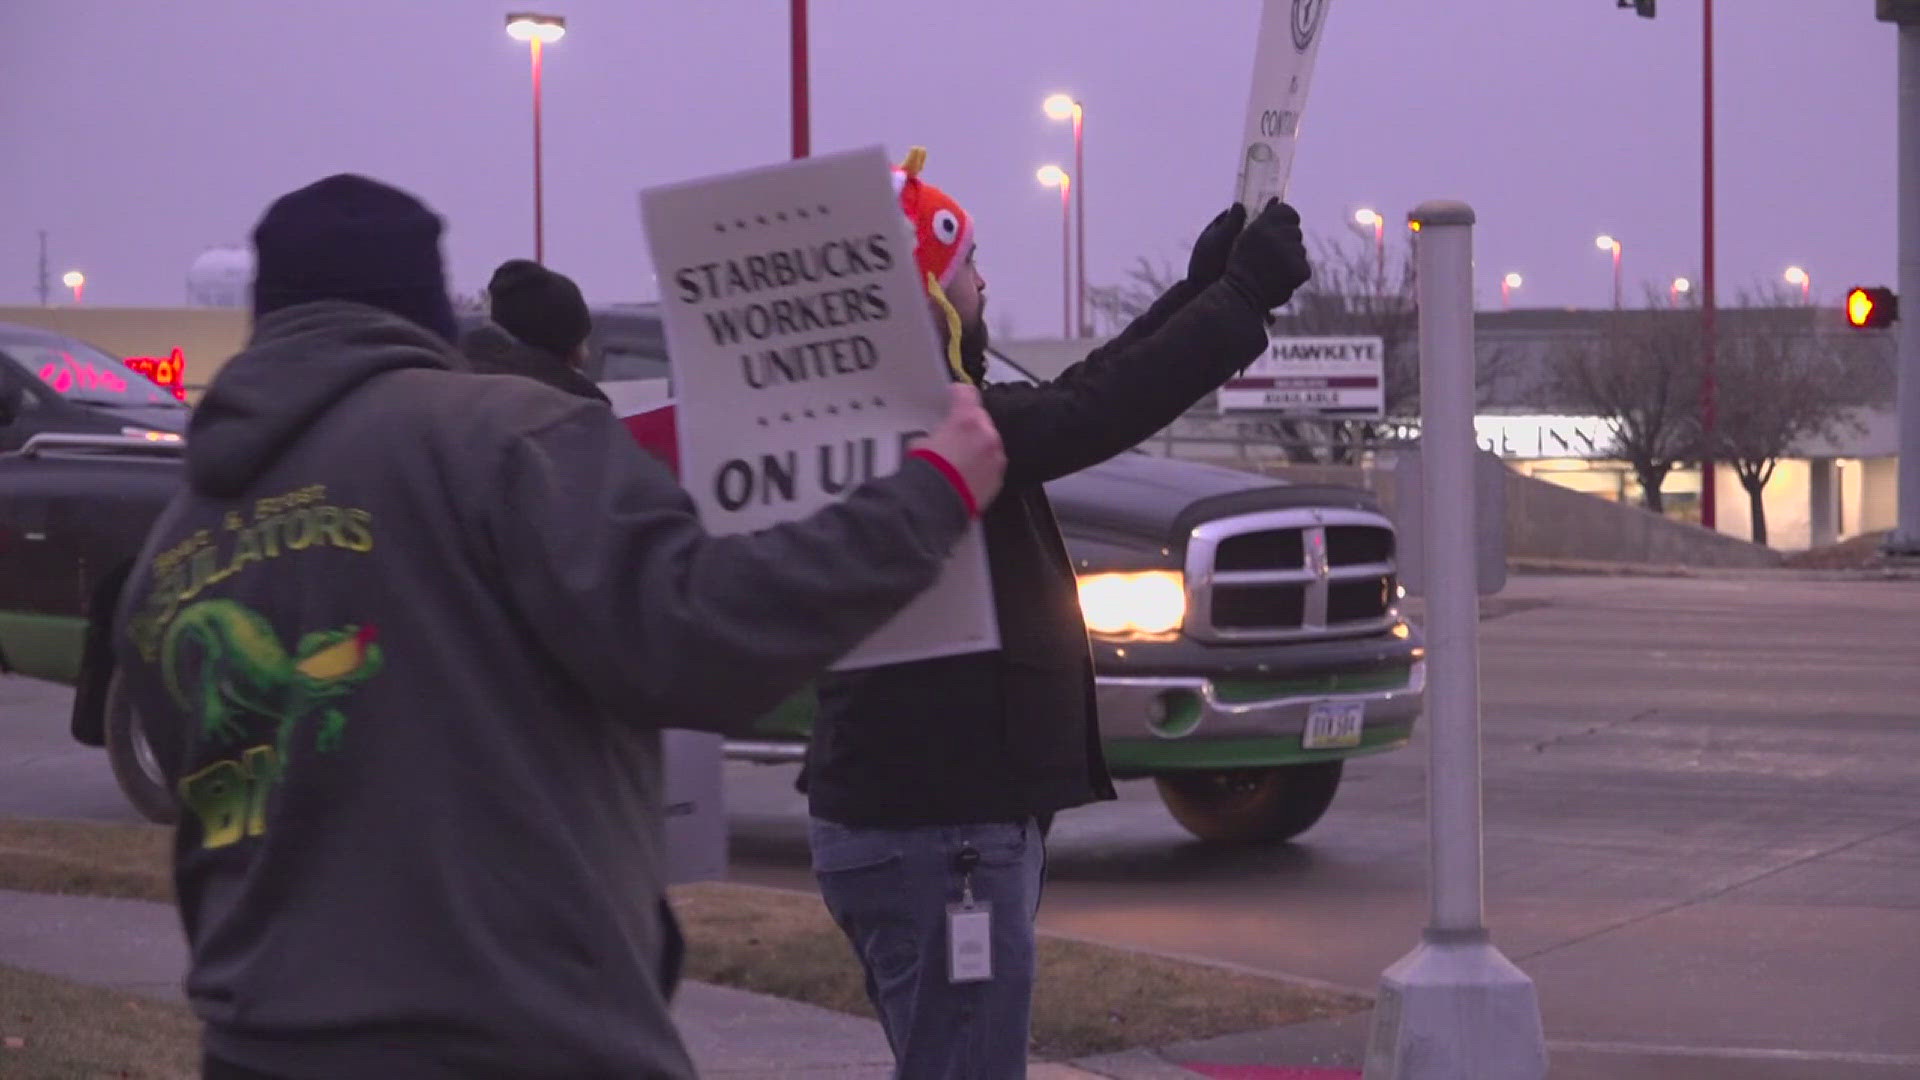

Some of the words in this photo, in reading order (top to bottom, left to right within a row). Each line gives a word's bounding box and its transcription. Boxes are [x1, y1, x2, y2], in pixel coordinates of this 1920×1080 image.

[676, 234, 892, 304] STARBUCKS
[705, 284, 890, 346] WORKERS
[742, 336, 877, 389] UNITED
[1271, 343, 1376, 361] HAWKEYE
[715, 450, 797, 513] ON
